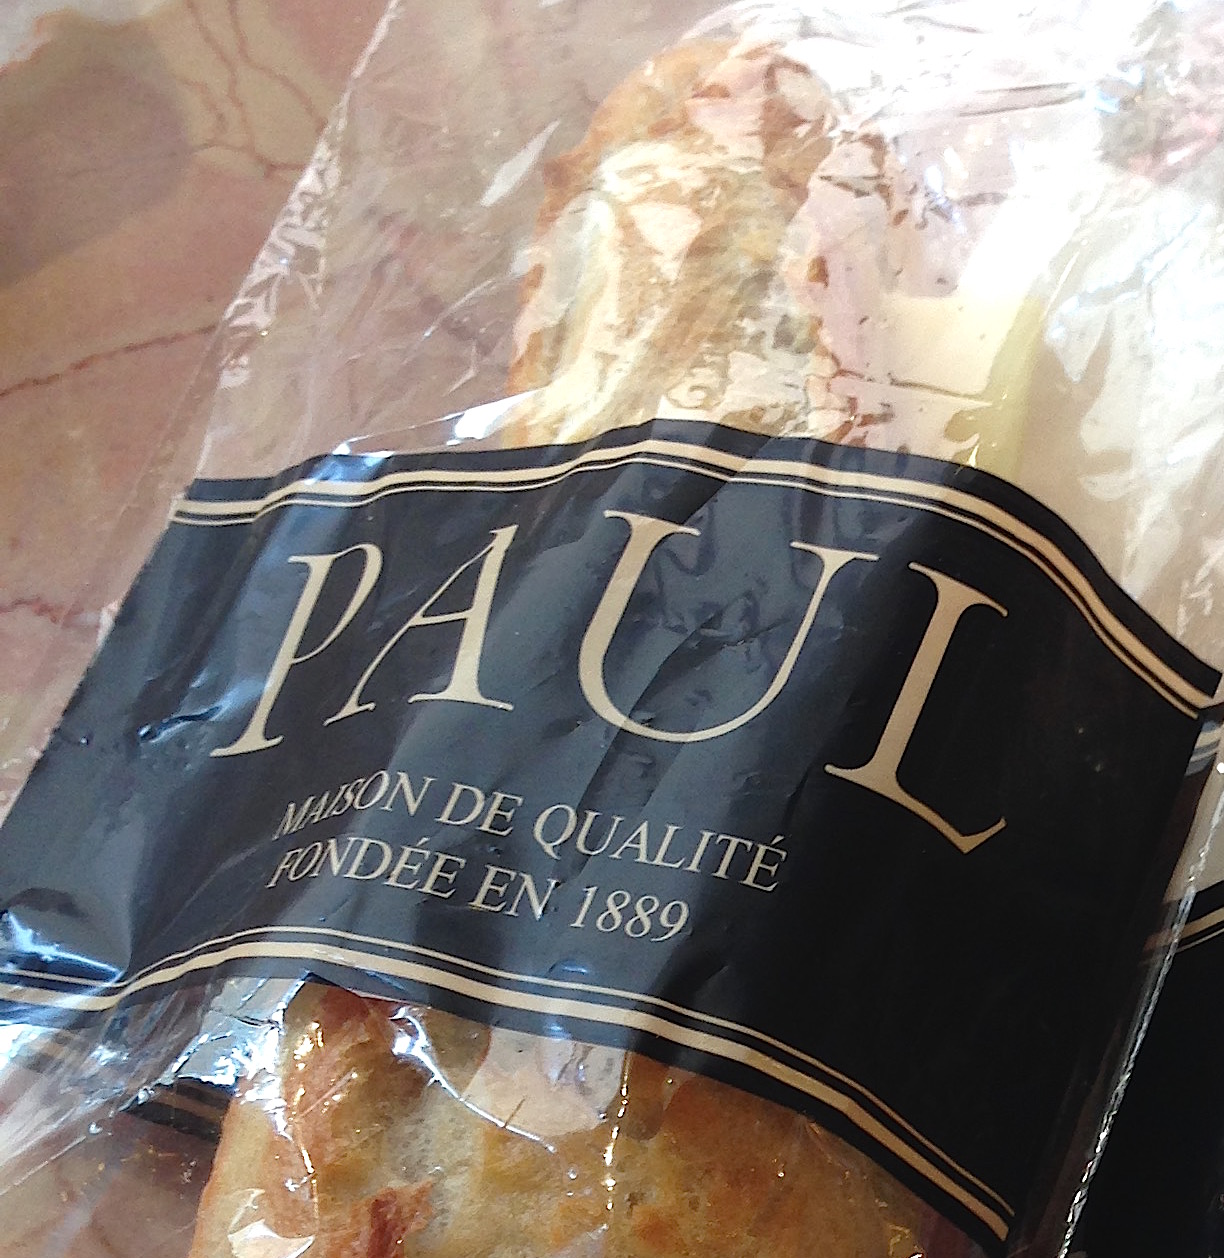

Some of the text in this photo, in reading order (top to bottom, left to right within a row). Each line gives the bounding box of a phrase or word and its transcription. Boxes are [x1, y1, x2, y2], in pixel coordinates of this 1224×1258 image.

[209, 509, 1009, 854] PAUL
[264, 836, 691, 943] FONDÉE EN 1889
[271, 769, 789, 893] MAISON DE QUALITÉ
